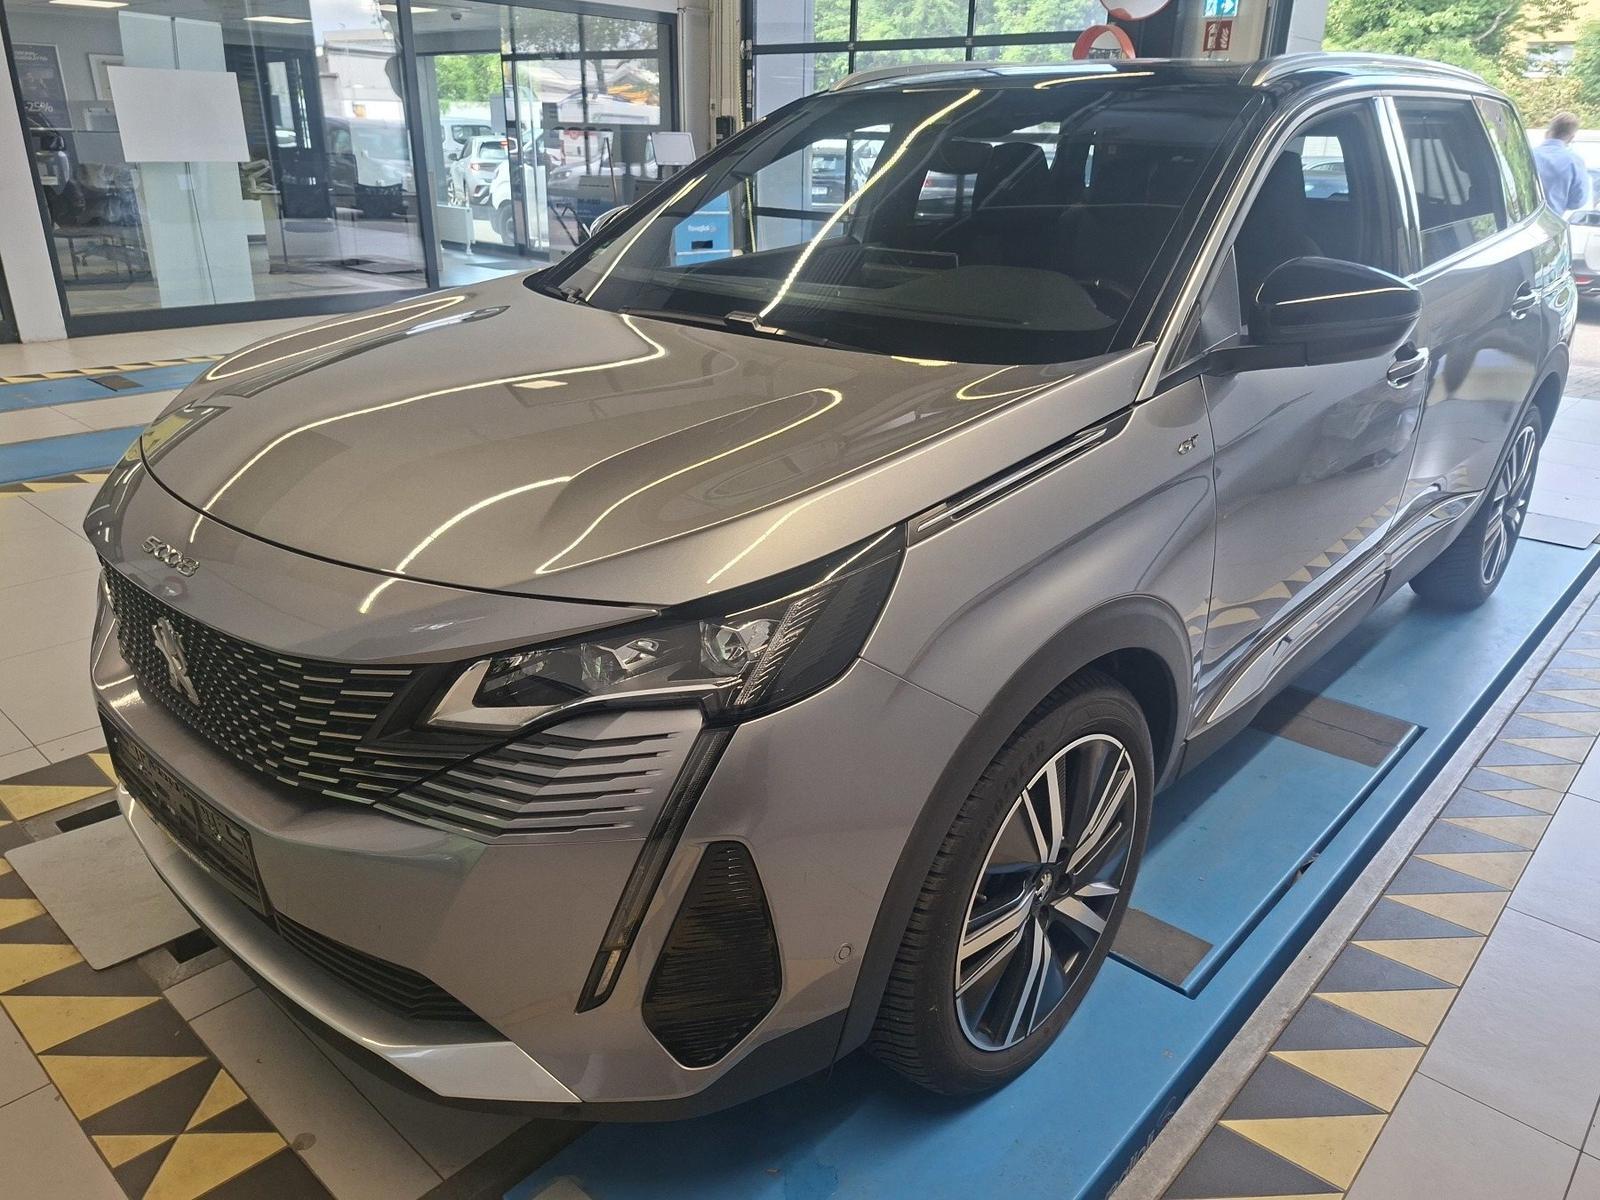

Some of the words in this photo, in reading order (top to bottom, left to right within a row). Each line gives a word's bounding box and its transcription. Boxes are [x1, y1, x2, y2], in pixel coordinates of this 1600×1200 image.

[25, 102, 54, 113] -25%
[1178, 433, 1199, 455] GT
[142, 535, 200, 577] 5008
